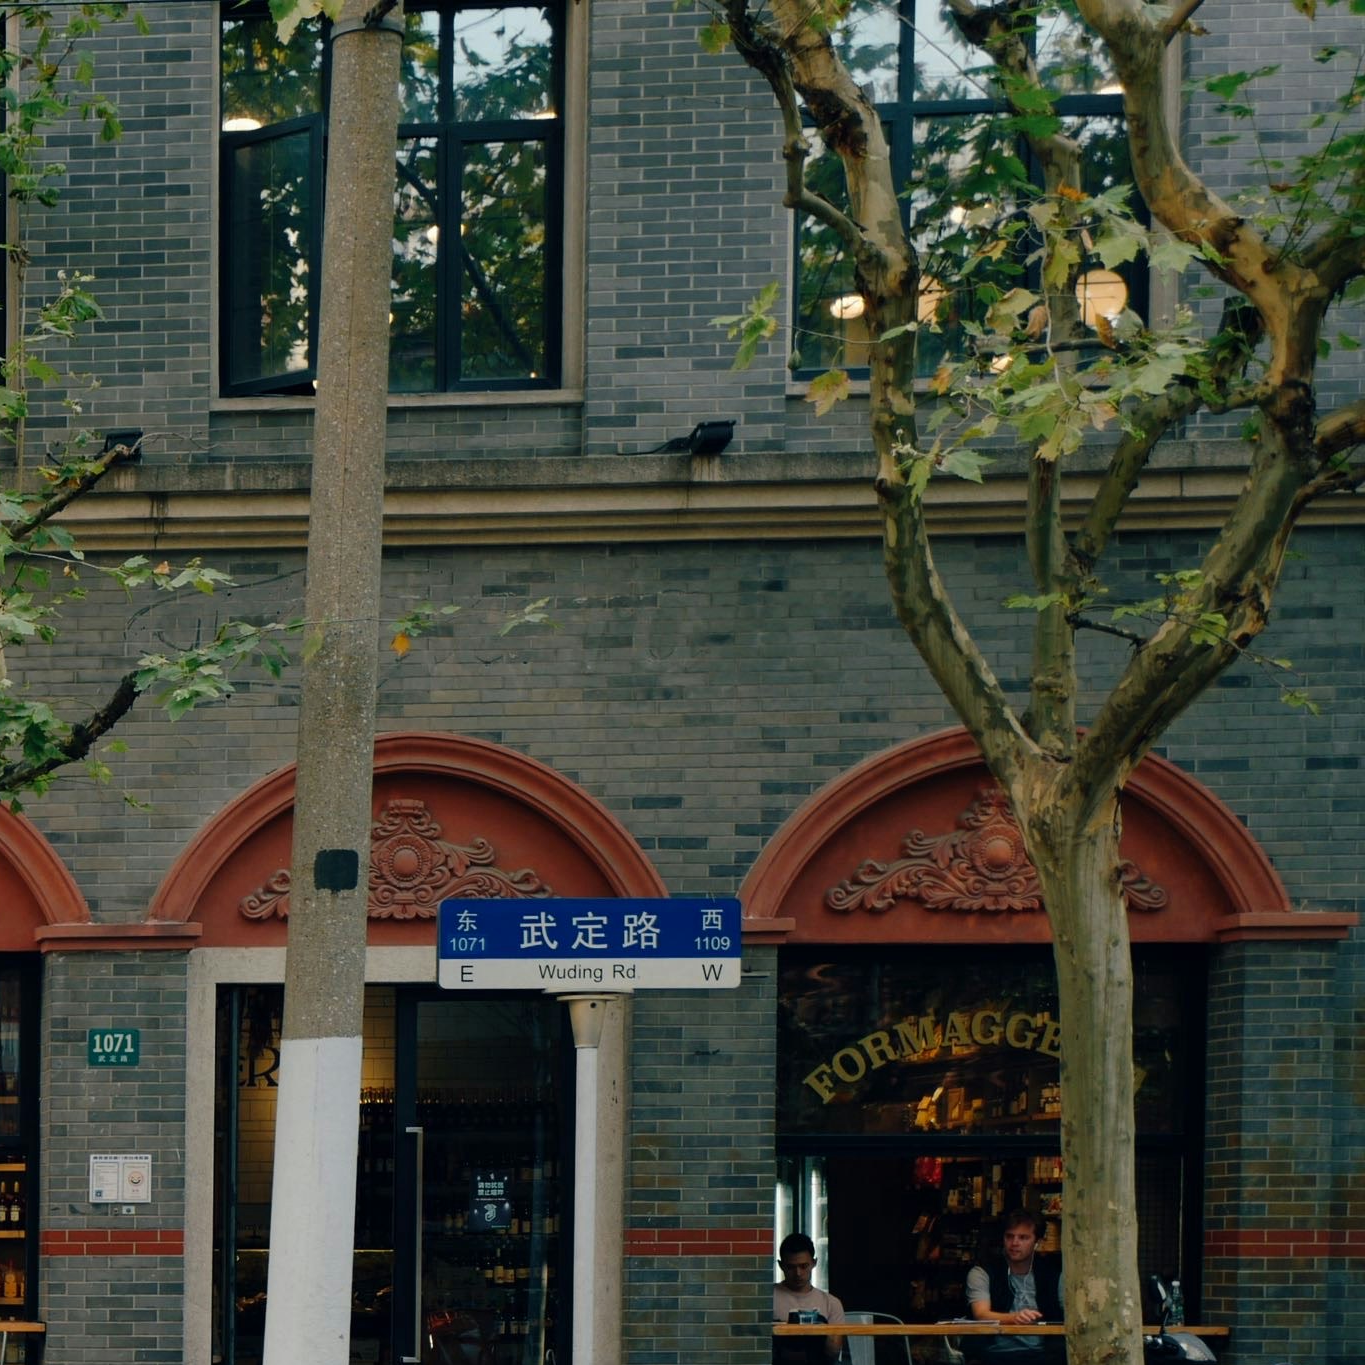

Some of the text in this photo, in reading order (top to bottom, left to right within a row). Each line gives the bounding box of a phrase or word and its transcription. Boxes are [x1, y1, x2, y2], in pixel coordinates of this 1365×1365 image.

[456, 909, 478, 932] 东
[700, 909, 724, 931] 西
[519, 911, 661, 950] 武定路
[449, 937, 486, 951] 1071
[694, 936, 731, 951] 1109
[460, 965, 474, 982] E
[538, 964, 603, 983] Wuding
[701, 963, 724, 982] W
[92, 1033, 135, 1053] 1071
